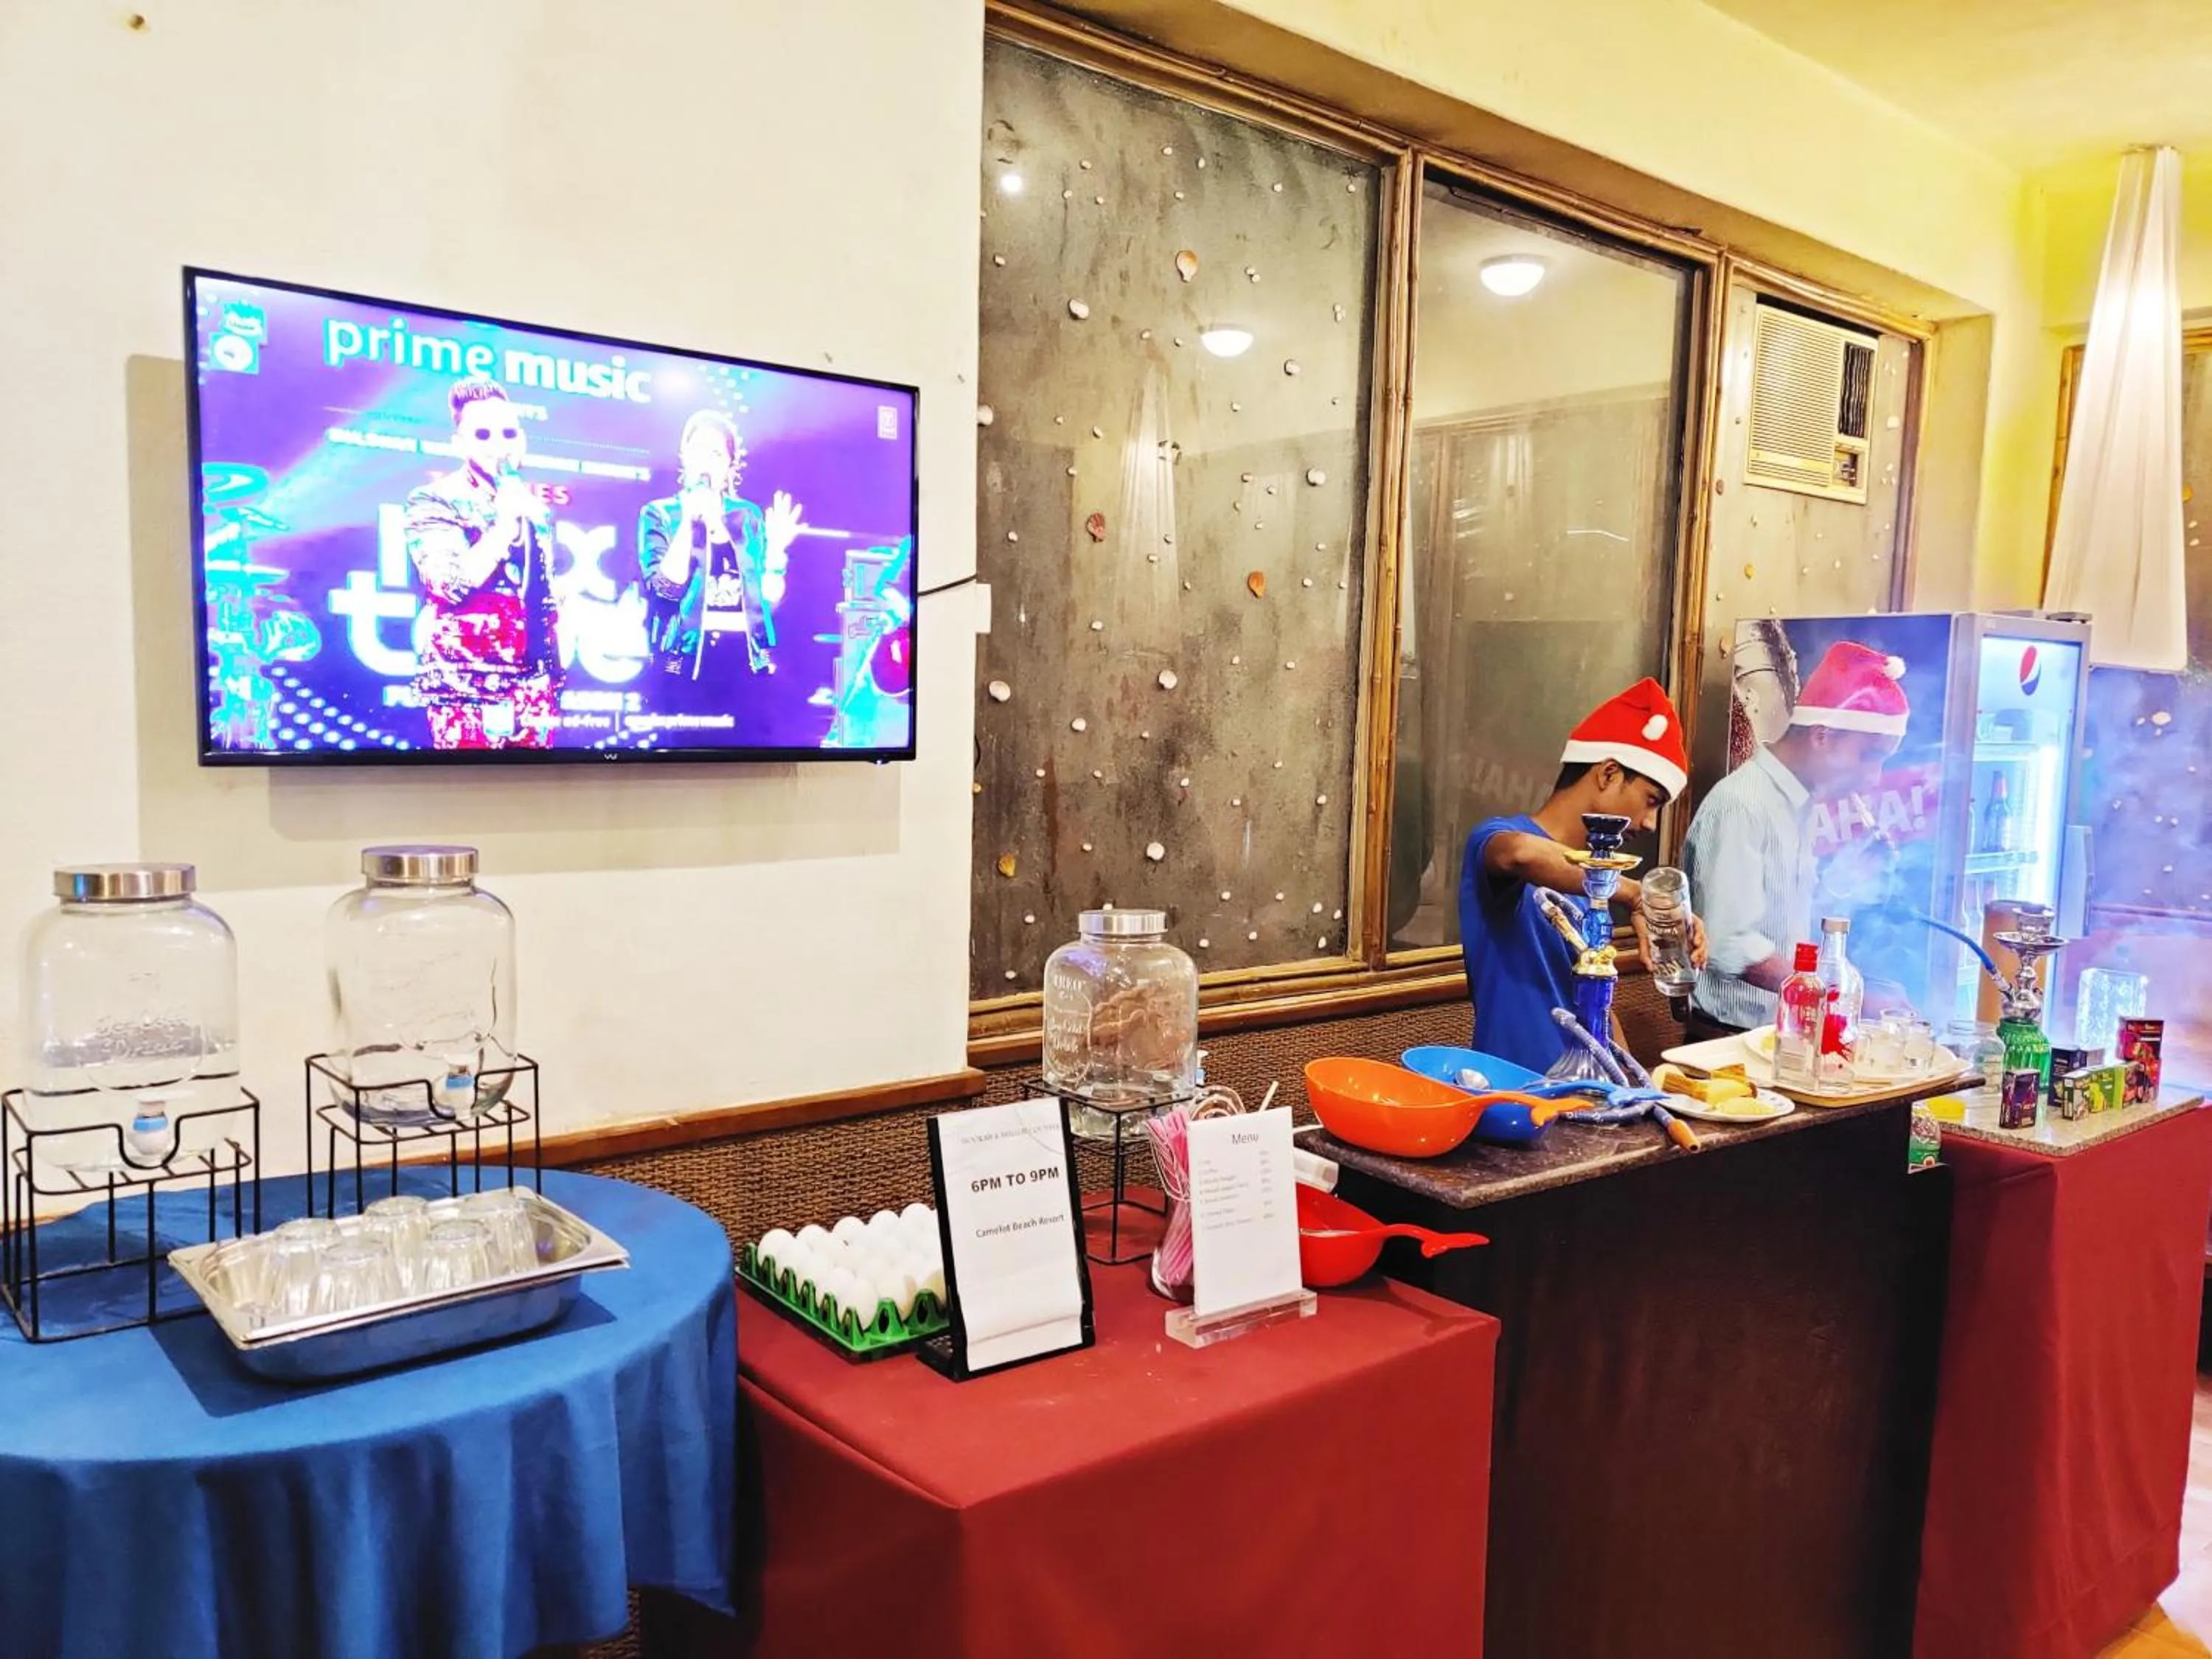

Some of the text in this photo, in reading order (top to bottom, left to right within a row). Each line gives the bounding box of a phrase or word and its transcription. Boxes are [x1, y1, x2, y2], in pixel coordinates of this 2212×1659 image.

[326, 318, 493, 378] prime
[505, 355, 652, 403] music
[1232, 1133, 1259, 1144] Menu
[971, 1166, 1060, 1192] 6PM TO 9PM
[975, 1214, 1064, 1238] Camelot Beach Resort
